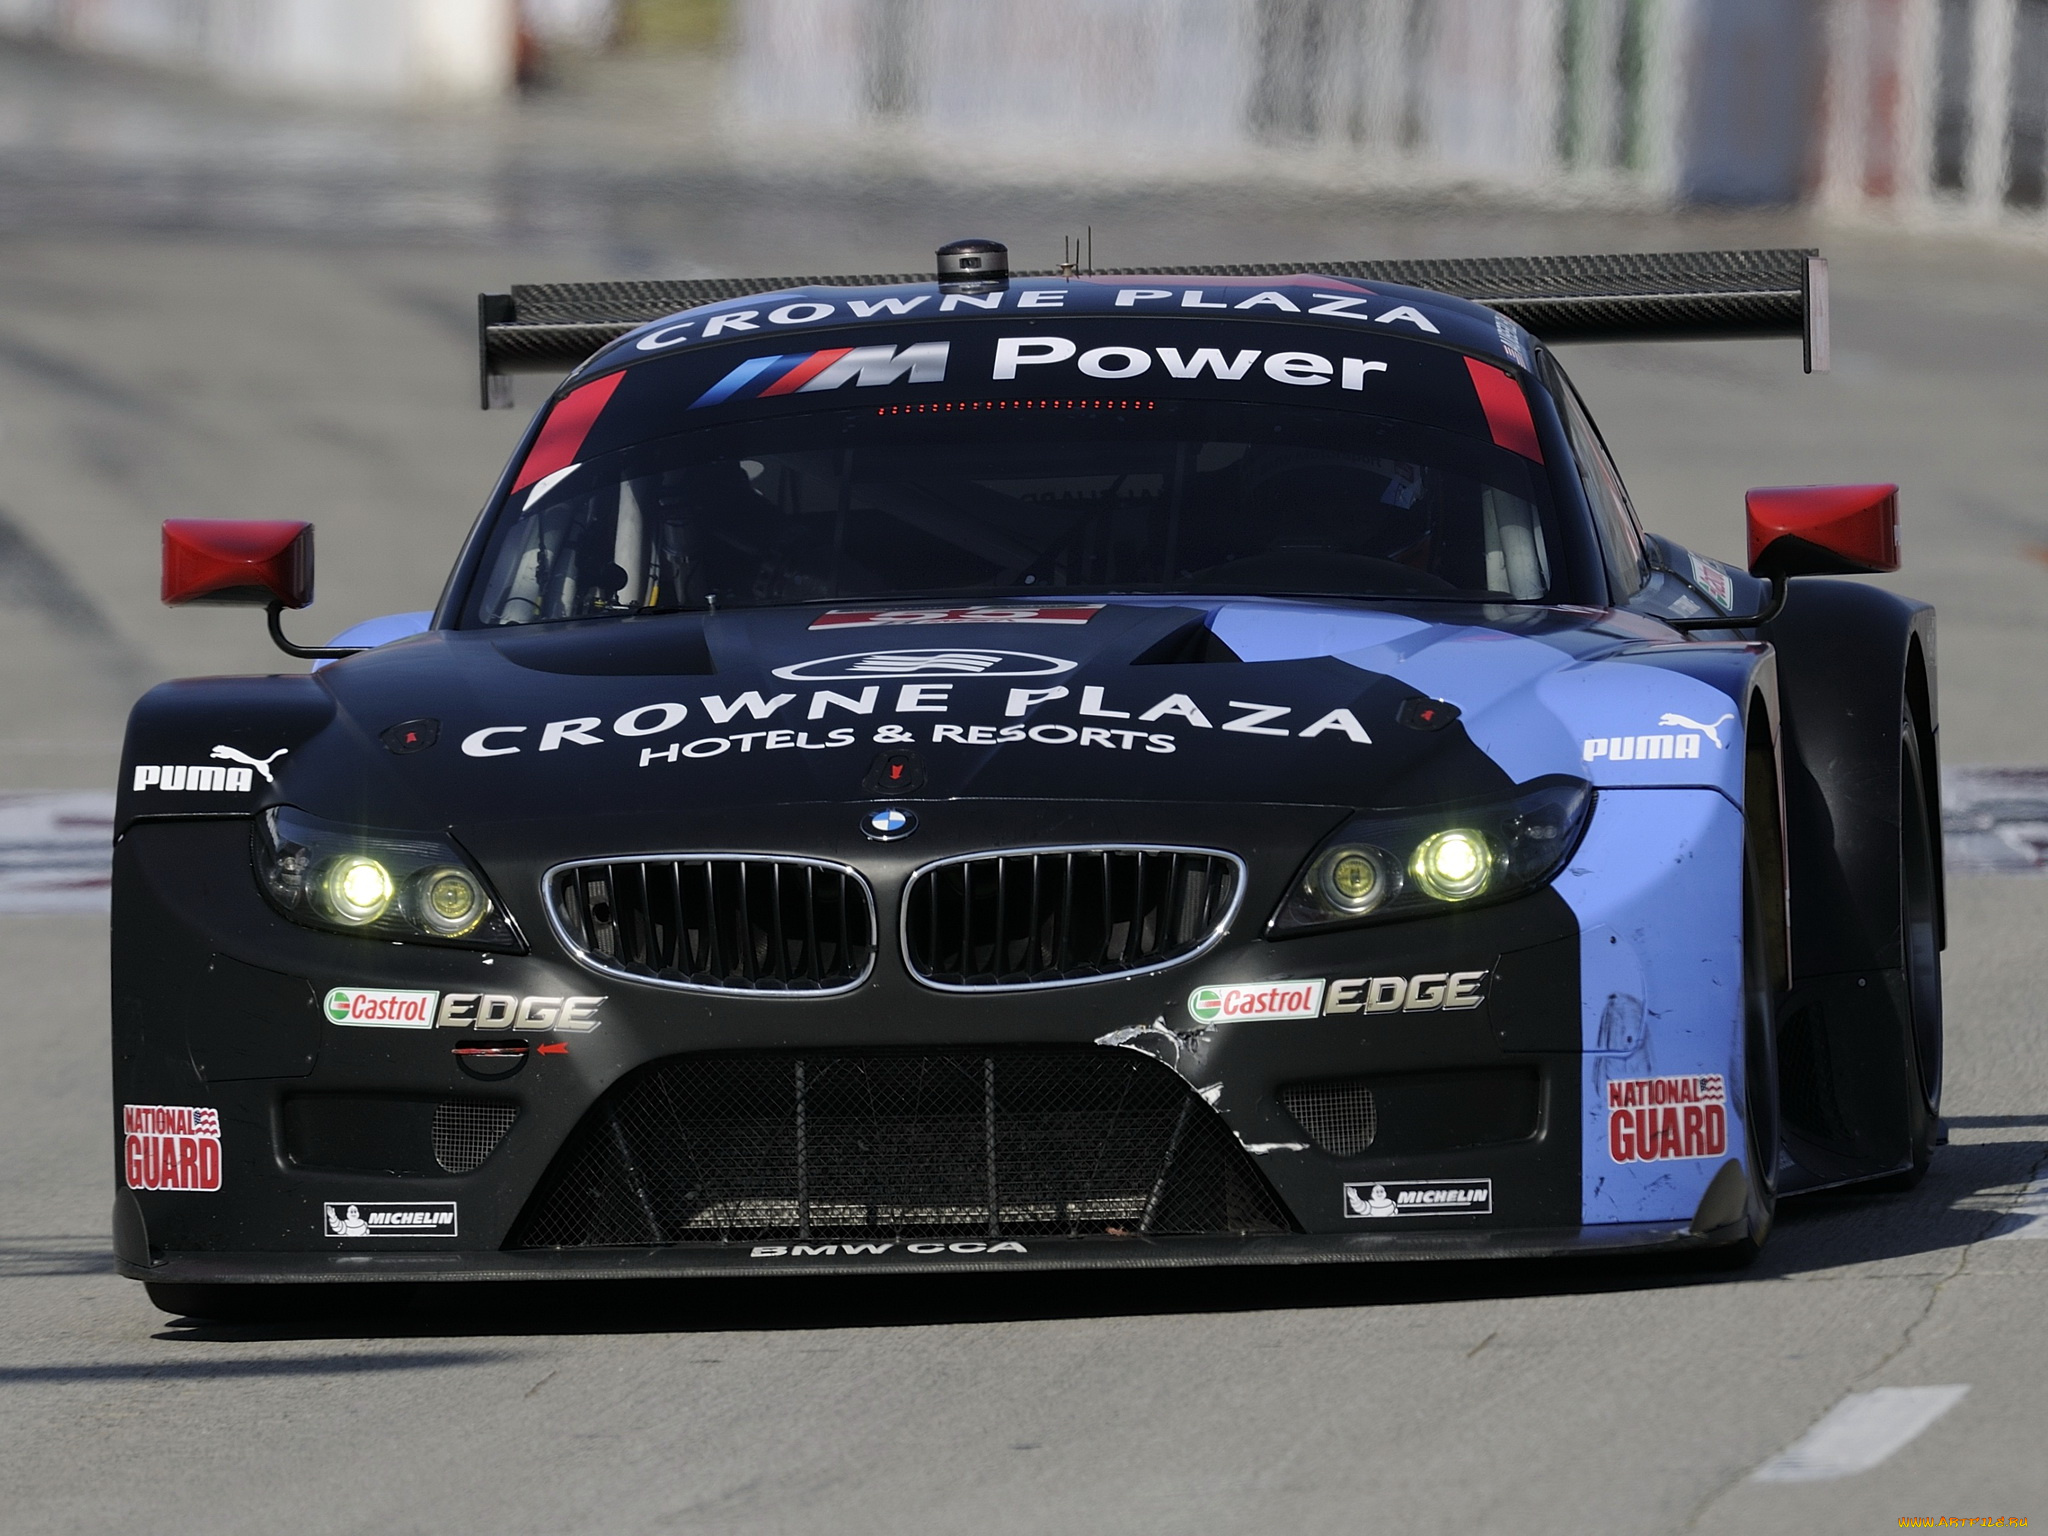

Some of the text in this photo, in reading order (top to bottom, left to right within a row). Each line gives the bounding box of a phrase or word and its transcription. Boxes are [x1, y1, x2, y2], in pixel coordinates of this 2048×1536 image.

[636, 290, 1068, 350] CROWNE
[1115, 289, 1440, 334] PLAZA
[993, 337, 1387, 390] Power
[461, 684, 1372, 757] CROWNE PLAZA
[639, 724, 1176, 767] HOTELS & RESORTS
[1583, 734, 1700, 761] PUMA
[133, 765, 253, 791] PUMA
[351, 993, 608, 1034] Castrol EDGE
[1223, 970, 1489, 1016] Castrol EDGE
[1609, 1078, 1701, 1109] NATIONAL
[124, 1107, 194, 1135] NATIONAL
[1610, 1104, 1726, 1161] GUARD
[126, 1136, 219, 1190] GUARD
[1396, 1187, 1488, 1205] MICHELIN
[367, 1211, 454, 1226] MICHELIN
[751, 1241, 1028, 1257] BMW CCA
